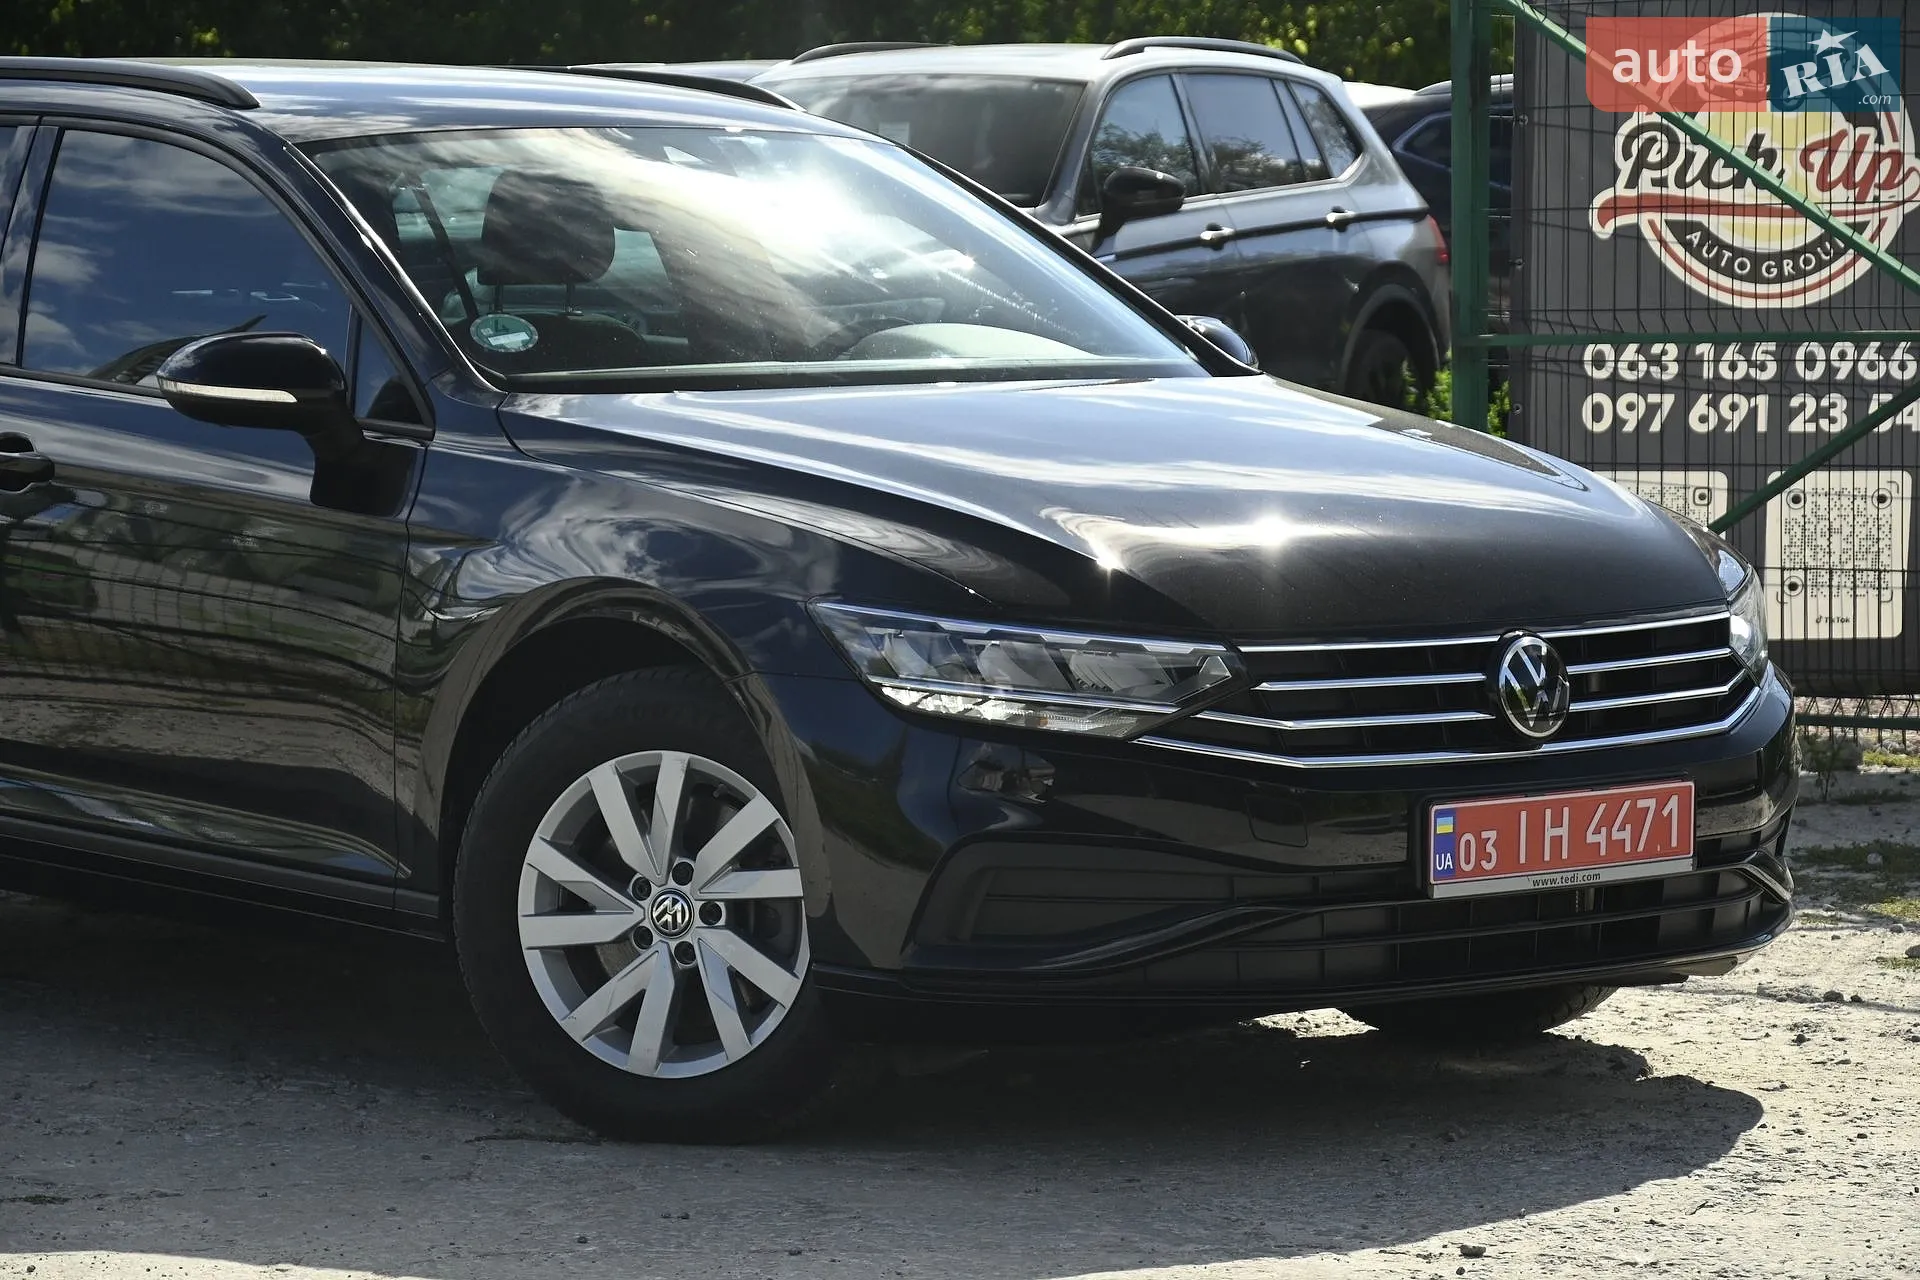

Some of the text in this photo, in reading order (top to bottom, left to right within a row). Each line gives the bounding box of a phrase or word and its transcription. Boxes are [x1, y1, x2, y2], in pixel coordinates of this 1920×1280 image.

[1800, 128, 1919, 204] Up
[1686, 231, 1751, 275] AUTO
[1583, 341, 1918, 381] 063 165 0966
[1582, 392, 1675, 433] 097
[1688, 393, 1769, 433] 691
[1788, 392, 1848, 433] 23
[1824, 616, 1850, 624] TkTok
[1436, 794, 1679, 872] UA 03 IH 4471
[1532, 871, 1601, 888] www.tedi.com
